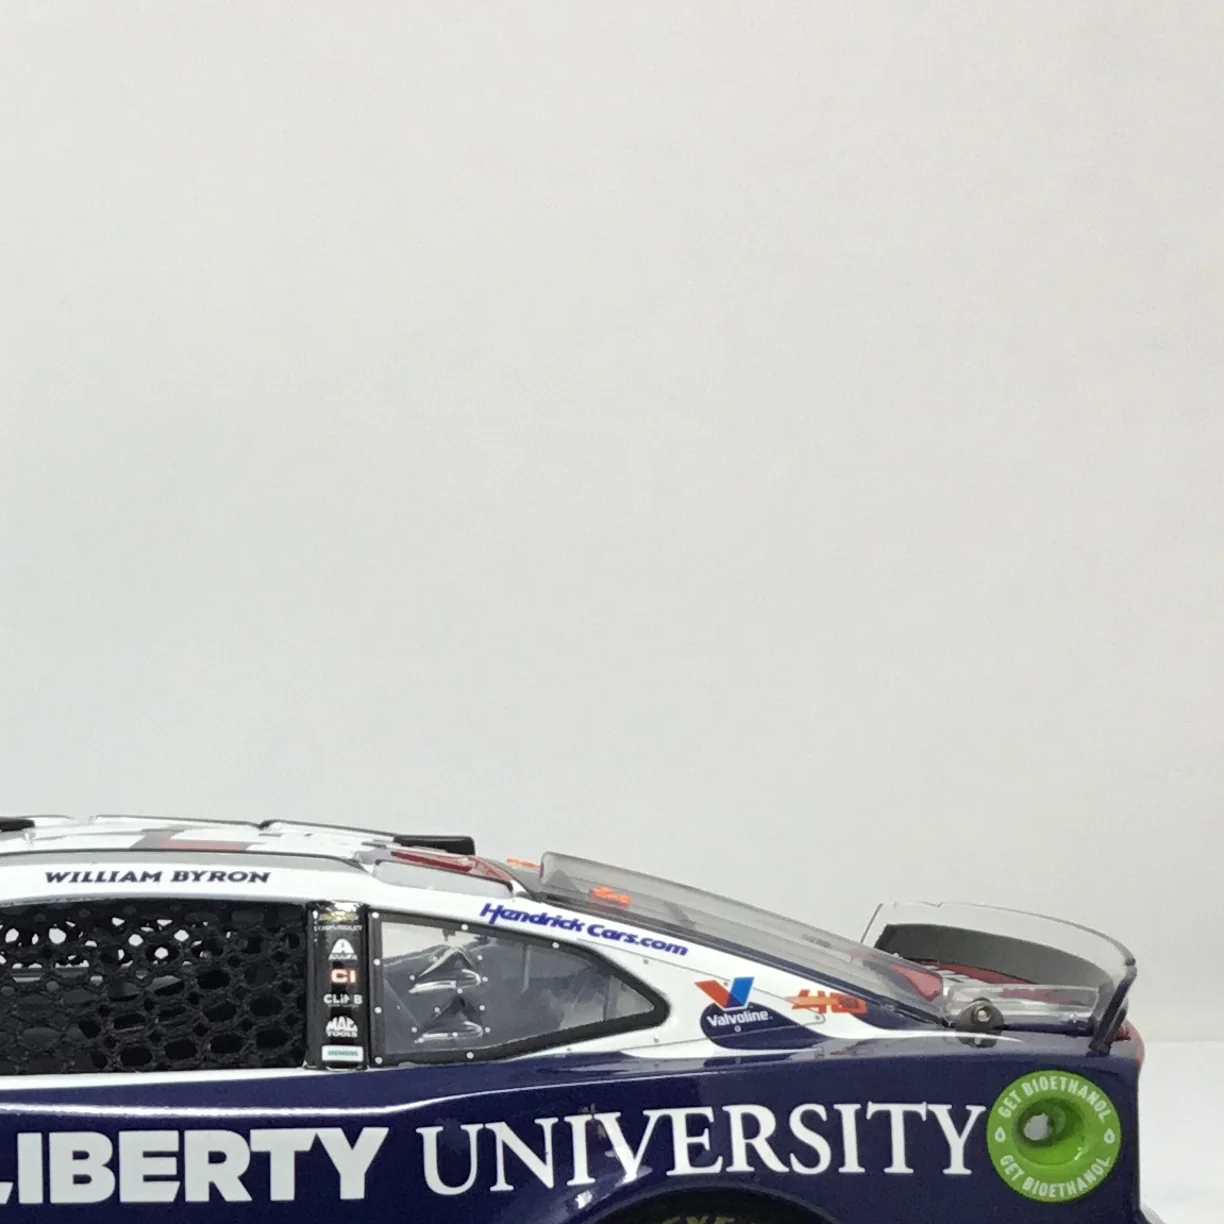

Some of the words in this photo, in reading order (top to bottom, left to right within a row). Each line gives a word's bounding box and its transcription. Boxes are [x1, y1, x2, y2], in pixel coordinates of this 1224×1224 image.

[44, 870, 163, 883] WILLIAM
[170, 870, 272, 883] BYRON
[479, 902, 586, 933] Hendrick
[587, 923, 689, 956] Cars.com
[331, 968, 356, 984] CI
[706, 1009, 770, 1028] Valvoline
[997, 1090, 1022, 1118] GET
[1021, 1076, 1112, 1124] BIOETHANOL
[416, 1101, 987, 1196] UNIVERSITY
[1000, 1154, 1025, 1180] GET
[1022, 1156, 1112, 1198] BIOETHANOL
